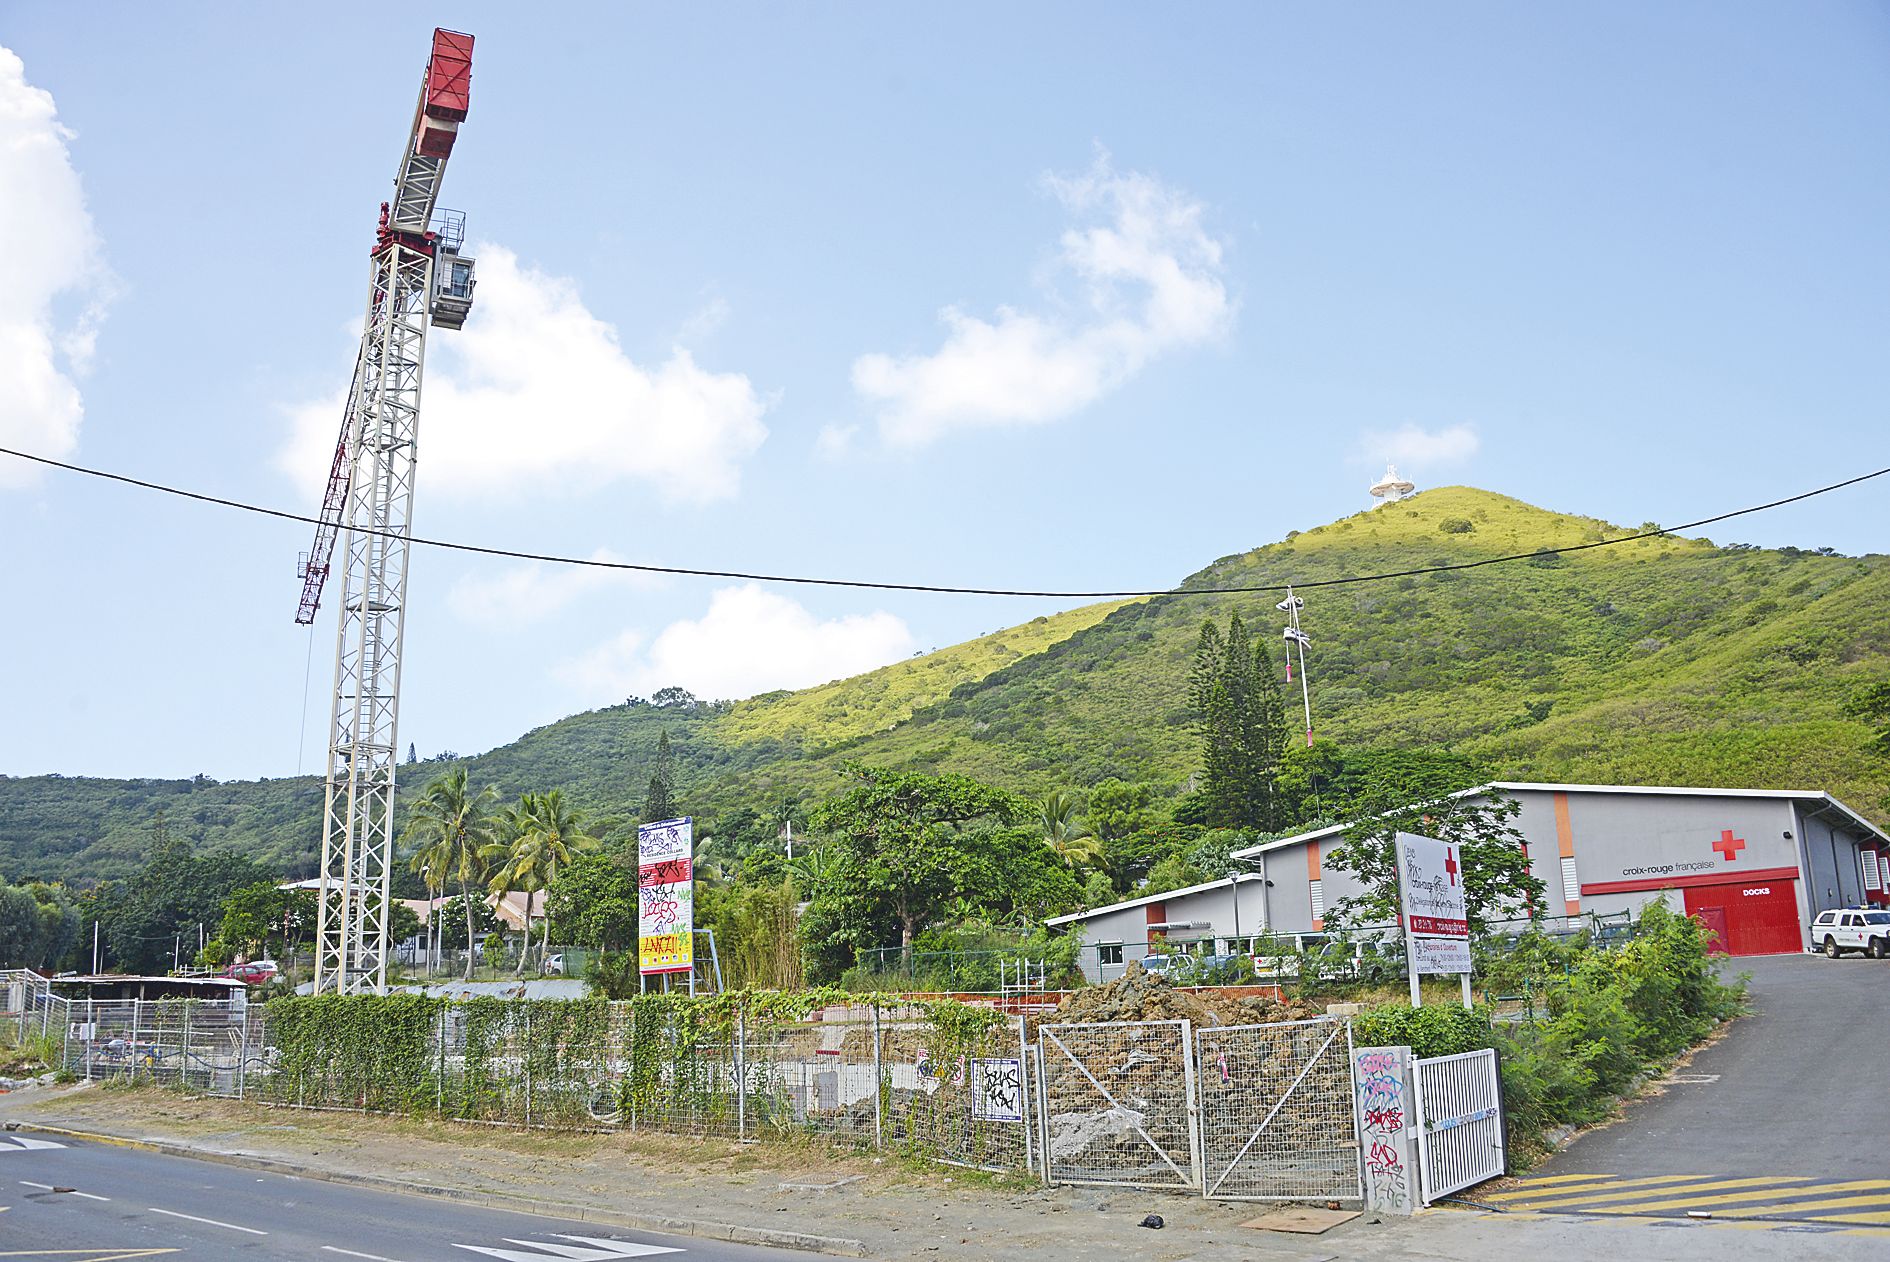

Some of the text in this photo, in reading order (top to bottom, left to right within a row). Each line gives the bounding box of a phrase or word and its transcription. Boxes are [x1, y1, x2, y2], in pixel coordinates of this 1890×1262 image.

[1622, 860, 1715, 876] croix-rouge française
[1742, 887, 1771, 897] DOCKS
